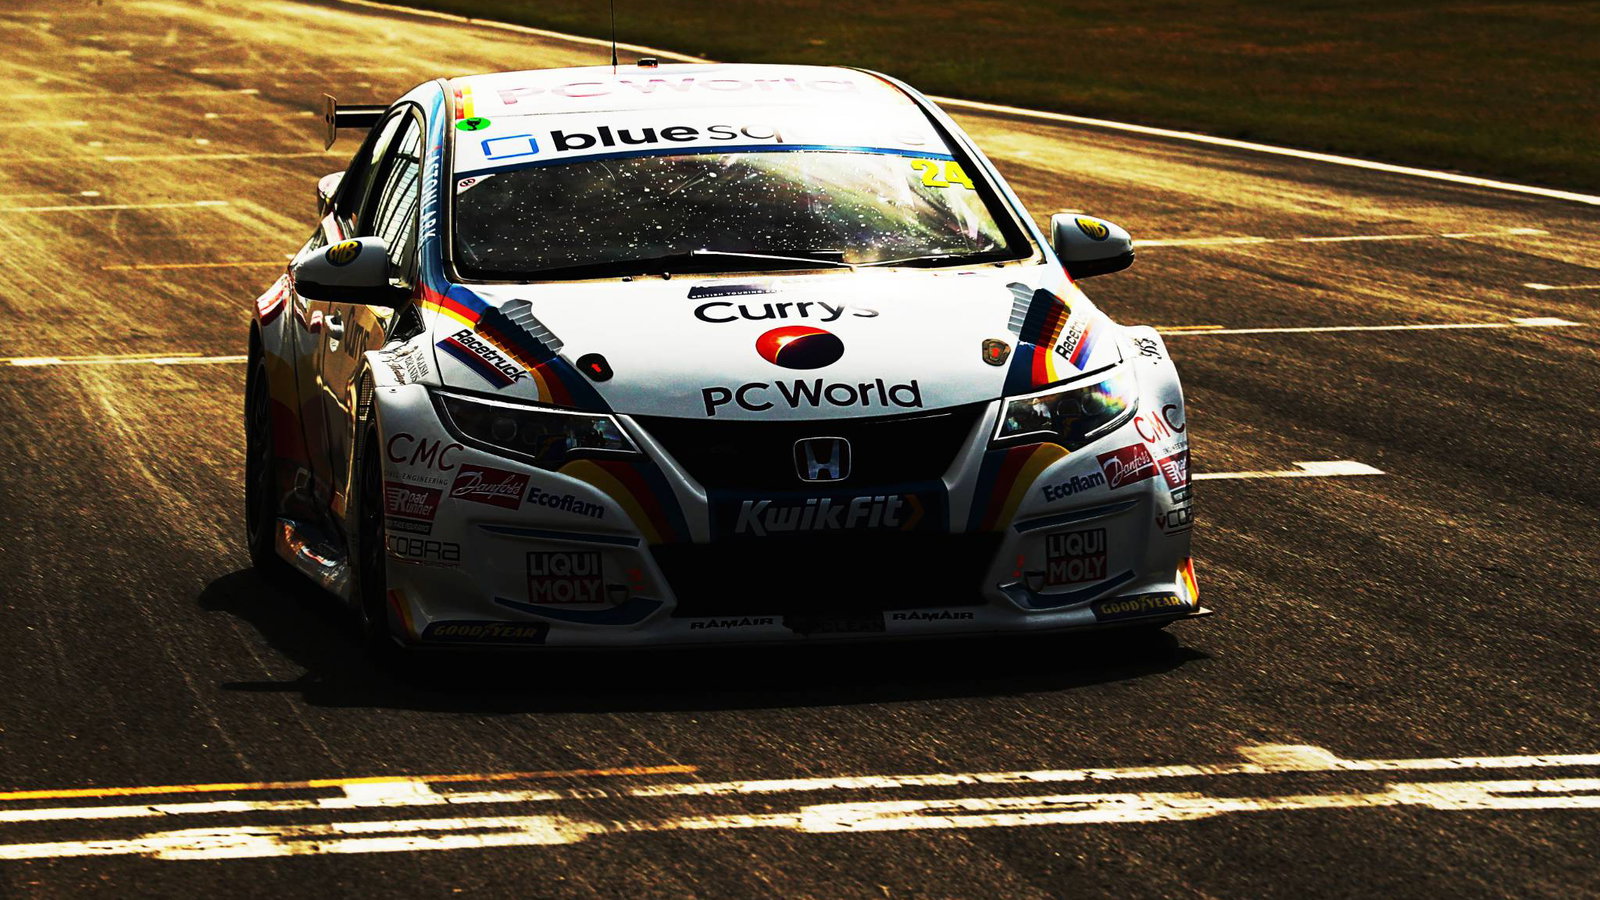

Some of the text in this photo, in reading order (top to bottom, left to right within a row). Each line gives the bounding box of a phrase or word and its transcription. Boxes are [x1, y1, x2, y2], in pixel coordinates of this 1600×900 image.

[910, 159, 976, 191] 24
[693, 301, 880, 324] Currys
[450, 328, 531, 384] Racetruck
[1134, 403, 1186, 444] CMC
[387, 432, 465, 472] CMC
[1103, 448, 1155, 488] Danfoss
[452, 468, 525, 501] Danfoss
[1042, 470, 1106, 502] Ecoflam
[526, 488, 605, 519] Ecoflam
[1048, 529, 1105, 557] LIQUI
[529, 553, 600, 577] LIQUI
[1049, 555, 1105, 584] MOLY
[531, 578, 602, 603] MOLY
[432, 623, 538, 639] GOODYEAR
[690, 616, 774, 630] RAMAIR
[892, 611, 975, 622] RAMAIR
